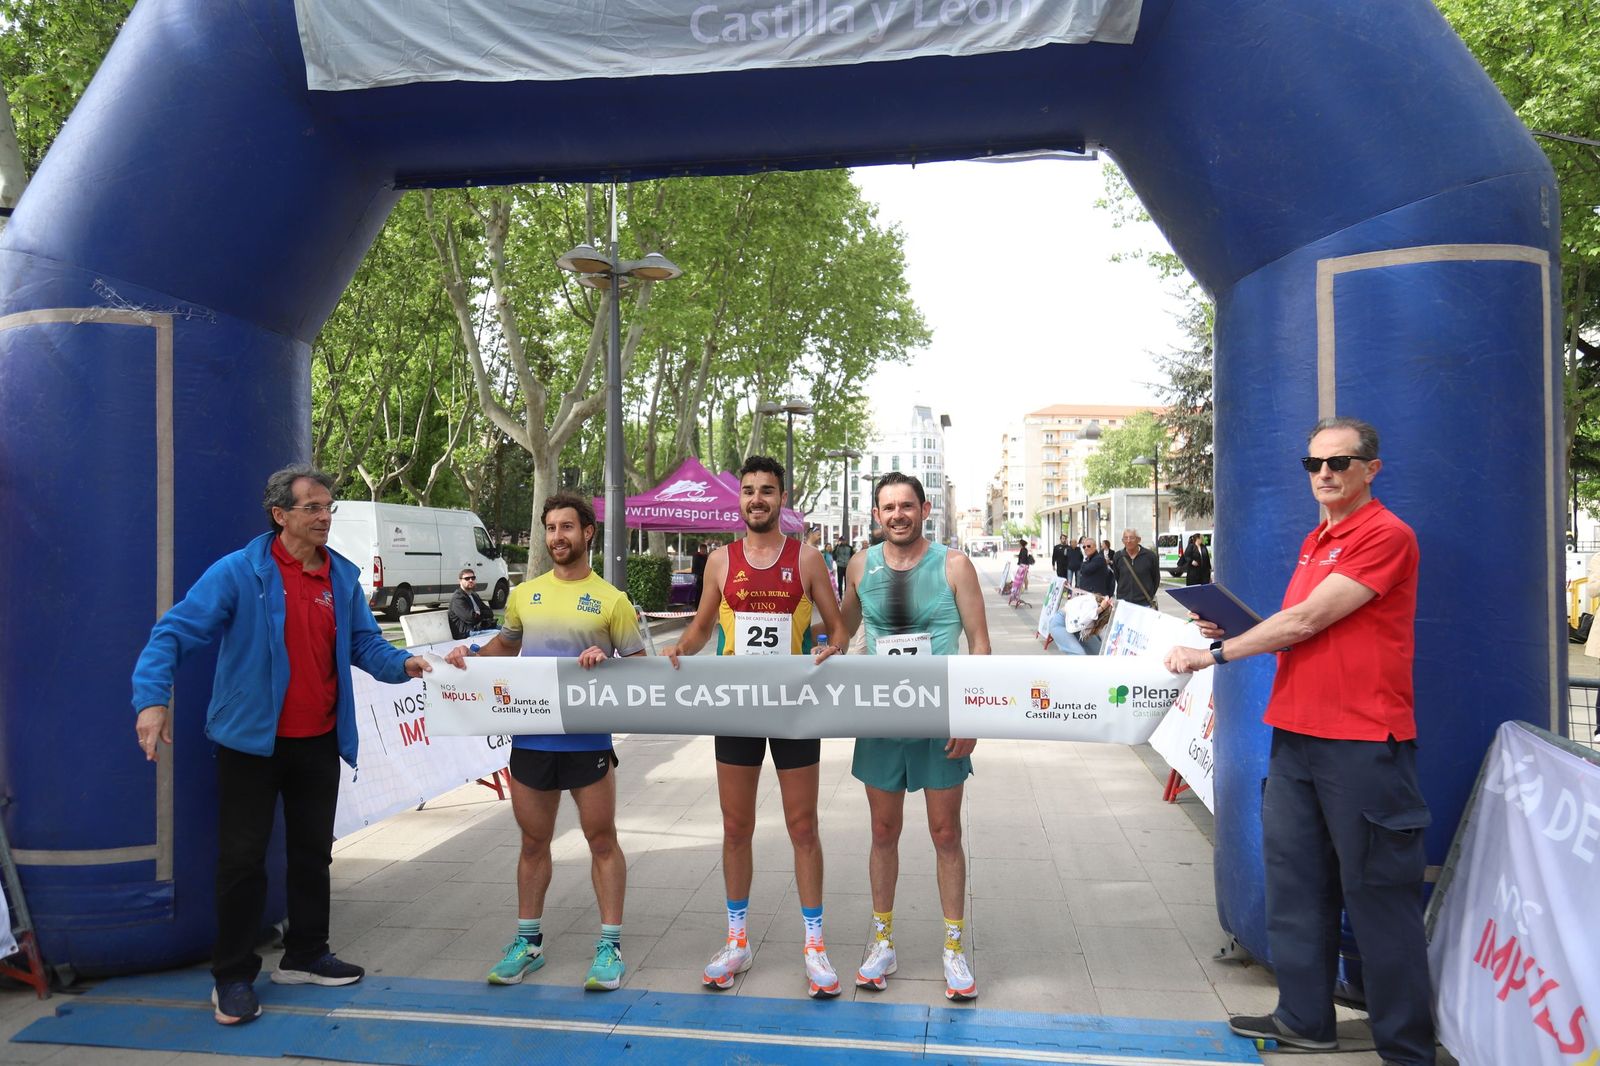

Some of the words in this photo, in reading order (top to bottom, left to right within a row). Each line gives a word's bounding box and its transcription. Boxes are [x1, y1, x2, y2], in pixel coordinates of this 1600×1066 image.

[690, 0, 855, 43] Castilla
[868, 1, 898, 43] y
[577, 605, 601, 614] DUERO
[751, 602, 776, 610] VINO
[747, 626, 779, 648] 25
[567, 679, 619, 707] DÍA
[627, 684, 667, 707] DE
[675, 684, 819, 707] CASTILLA
[826, 684, 845, 706] Y
[854, 679, 941, 708] LEÓN
[1132, 686, 1179, 699] Plena
[513, 698, 536, 706] Junta
[538, 698, 549, 706] de
[1053, 702, 1082, 711] Junta
[1084, 702, 1097, 710] de
[492, 705, 521, 713] Castilla
[530, 706, 551, 714] León
[1025, 711, 1061, 719] Castilla
[1063, 713, 1069, 721] y
[1072, 711, 1097, 720] León
[1542, 788, 1600, 864] DE
